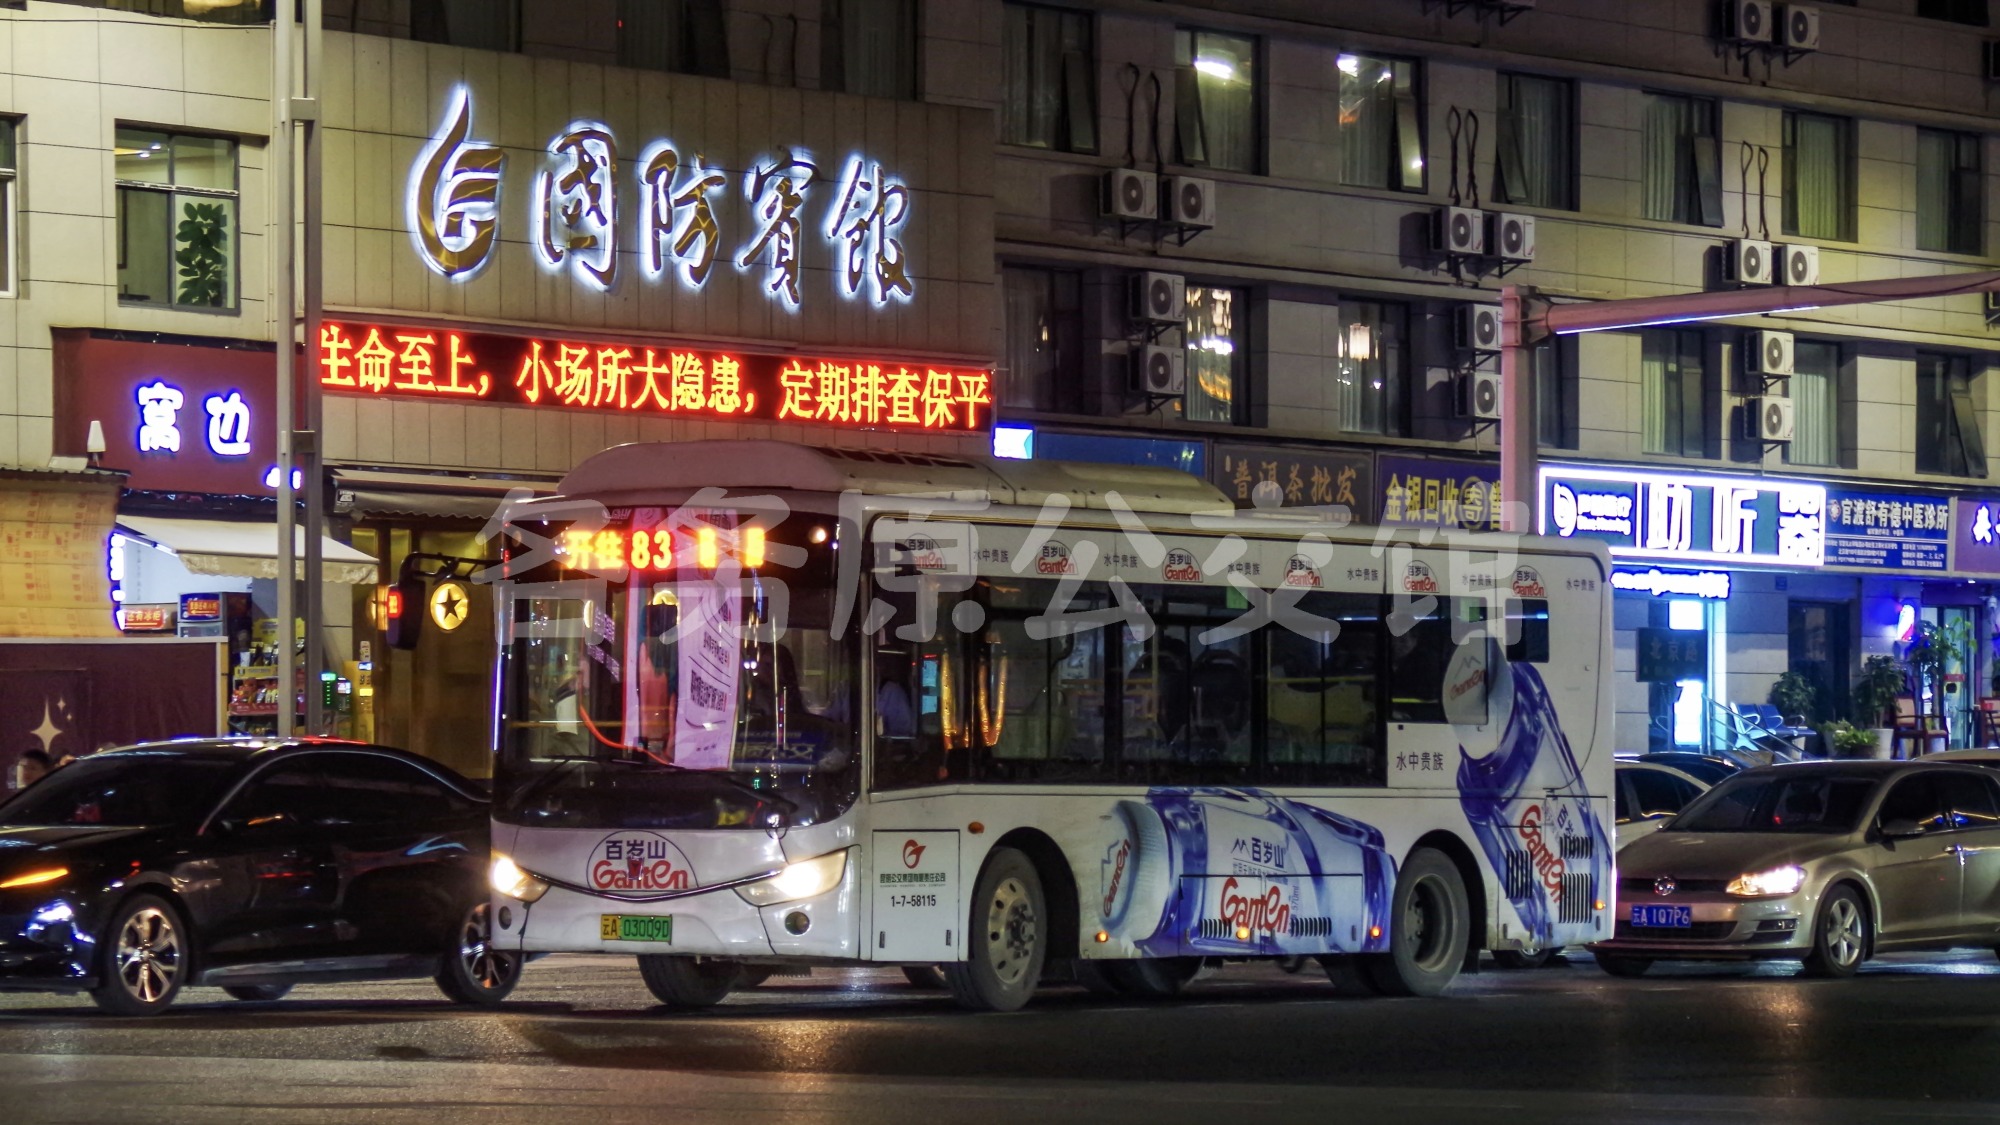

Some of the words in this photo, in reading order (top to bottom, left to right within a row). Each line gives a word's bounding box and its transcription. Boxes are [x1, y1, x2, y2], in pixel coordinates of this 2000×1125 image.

[1646, 483, 1820, 558] 助听器
[630, 530, 672, 569] 83
[1168, 553, 1192, 565] 百岁山
[914, 552, 943, 569] anten
[1103, 553, 1138, 569] 水中贵族
[1347, 566, 1379, 582] 水中贵族
[1396, 751, 1444, 772] 水中贵族
[606, 839, 666, 860] 百岁山
[1252, 836, 1285, 869] 百岁山
[890, 894, 937, 908] 1-7-58115
